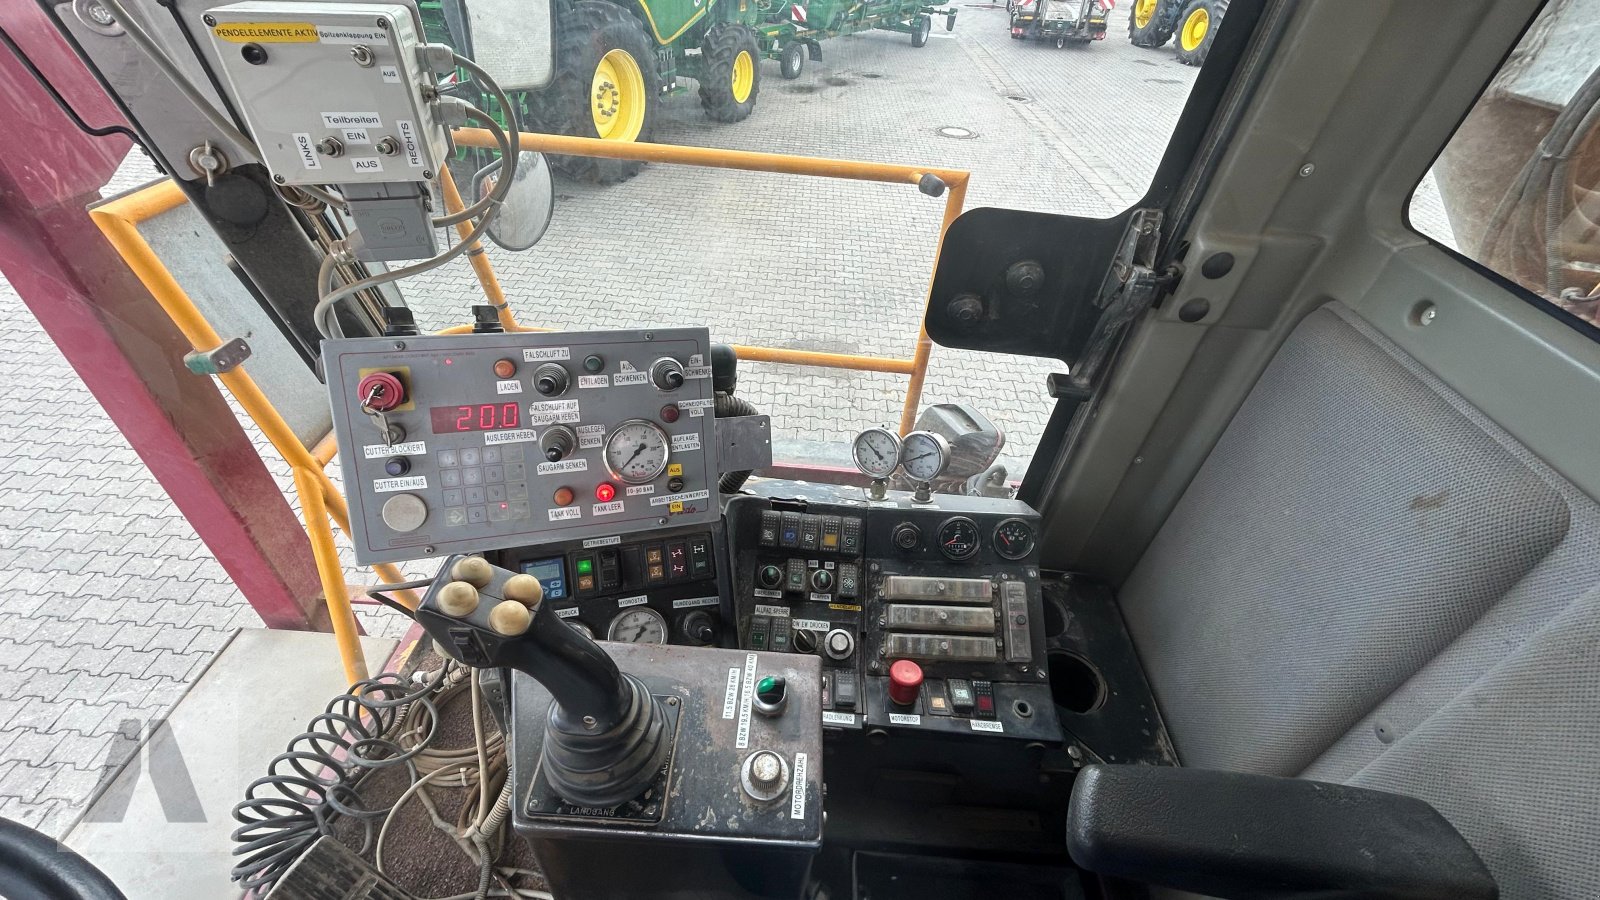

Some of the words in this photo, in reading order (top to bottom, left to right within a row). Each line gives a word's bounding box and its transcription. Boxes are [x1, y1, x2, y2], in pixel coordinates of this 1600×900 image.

[216, 28, 293, 38] PENDELELEMENTE
[294, 28, 319, 37] AKTIV
[320, 31, 374, 40] Spitzenklappung
[324, 114, 379, 124] Teilbreiten
[346, 132, 366, 140] EIN
[400, 122, 419, 166] RECHTS
[298, 136, 316, 167] LINKS
[356, 160, 378, 169] AUS
[525, 349, 562, 360] FALSCHLUFT
[562, 348, 569, 358] ZU
[580, 377, 608, 386] ENTLADEN
[614, 374, 646, 383] SCHWENKEN
[500, 382, 519, 392] LADEN
[530, 402, 566, 412] FALSCHLUFT
[566, 402, 578, 410] AUF
[456, 404, 518, 430] 20.0
[534, 415, 558, 424] SAUGARM
[560, 413, 579, 422] HEBEN
[578, 426, 604, 434] AUSLEGER
[486, 432, 516, 443] AUSLEGER
[516, 432, 534, 440] HEBEN
[580, 437, 601, 446] SENKEN
[365, 446, 390, 456] CUTTER
[390, 444, 424, 454] BLOCKIERT
[672, 442, 700, 450] ENTLASTEN
[538, 462, 564, 472] SAUGARM
[565, 461, 586, 470] SENKEN
[374, 481, 399, 490] CUTTER
[400, 479, 425, 488] EIN/AUS
[594, 505, 607, 513] TANK
[608, 503, 622, 511] LEER
[550, 510, 564, 518] TANK
[564, 509, 580, 517] VOLL
[794, 756, 805, 816] MOTORDREHZAHL
